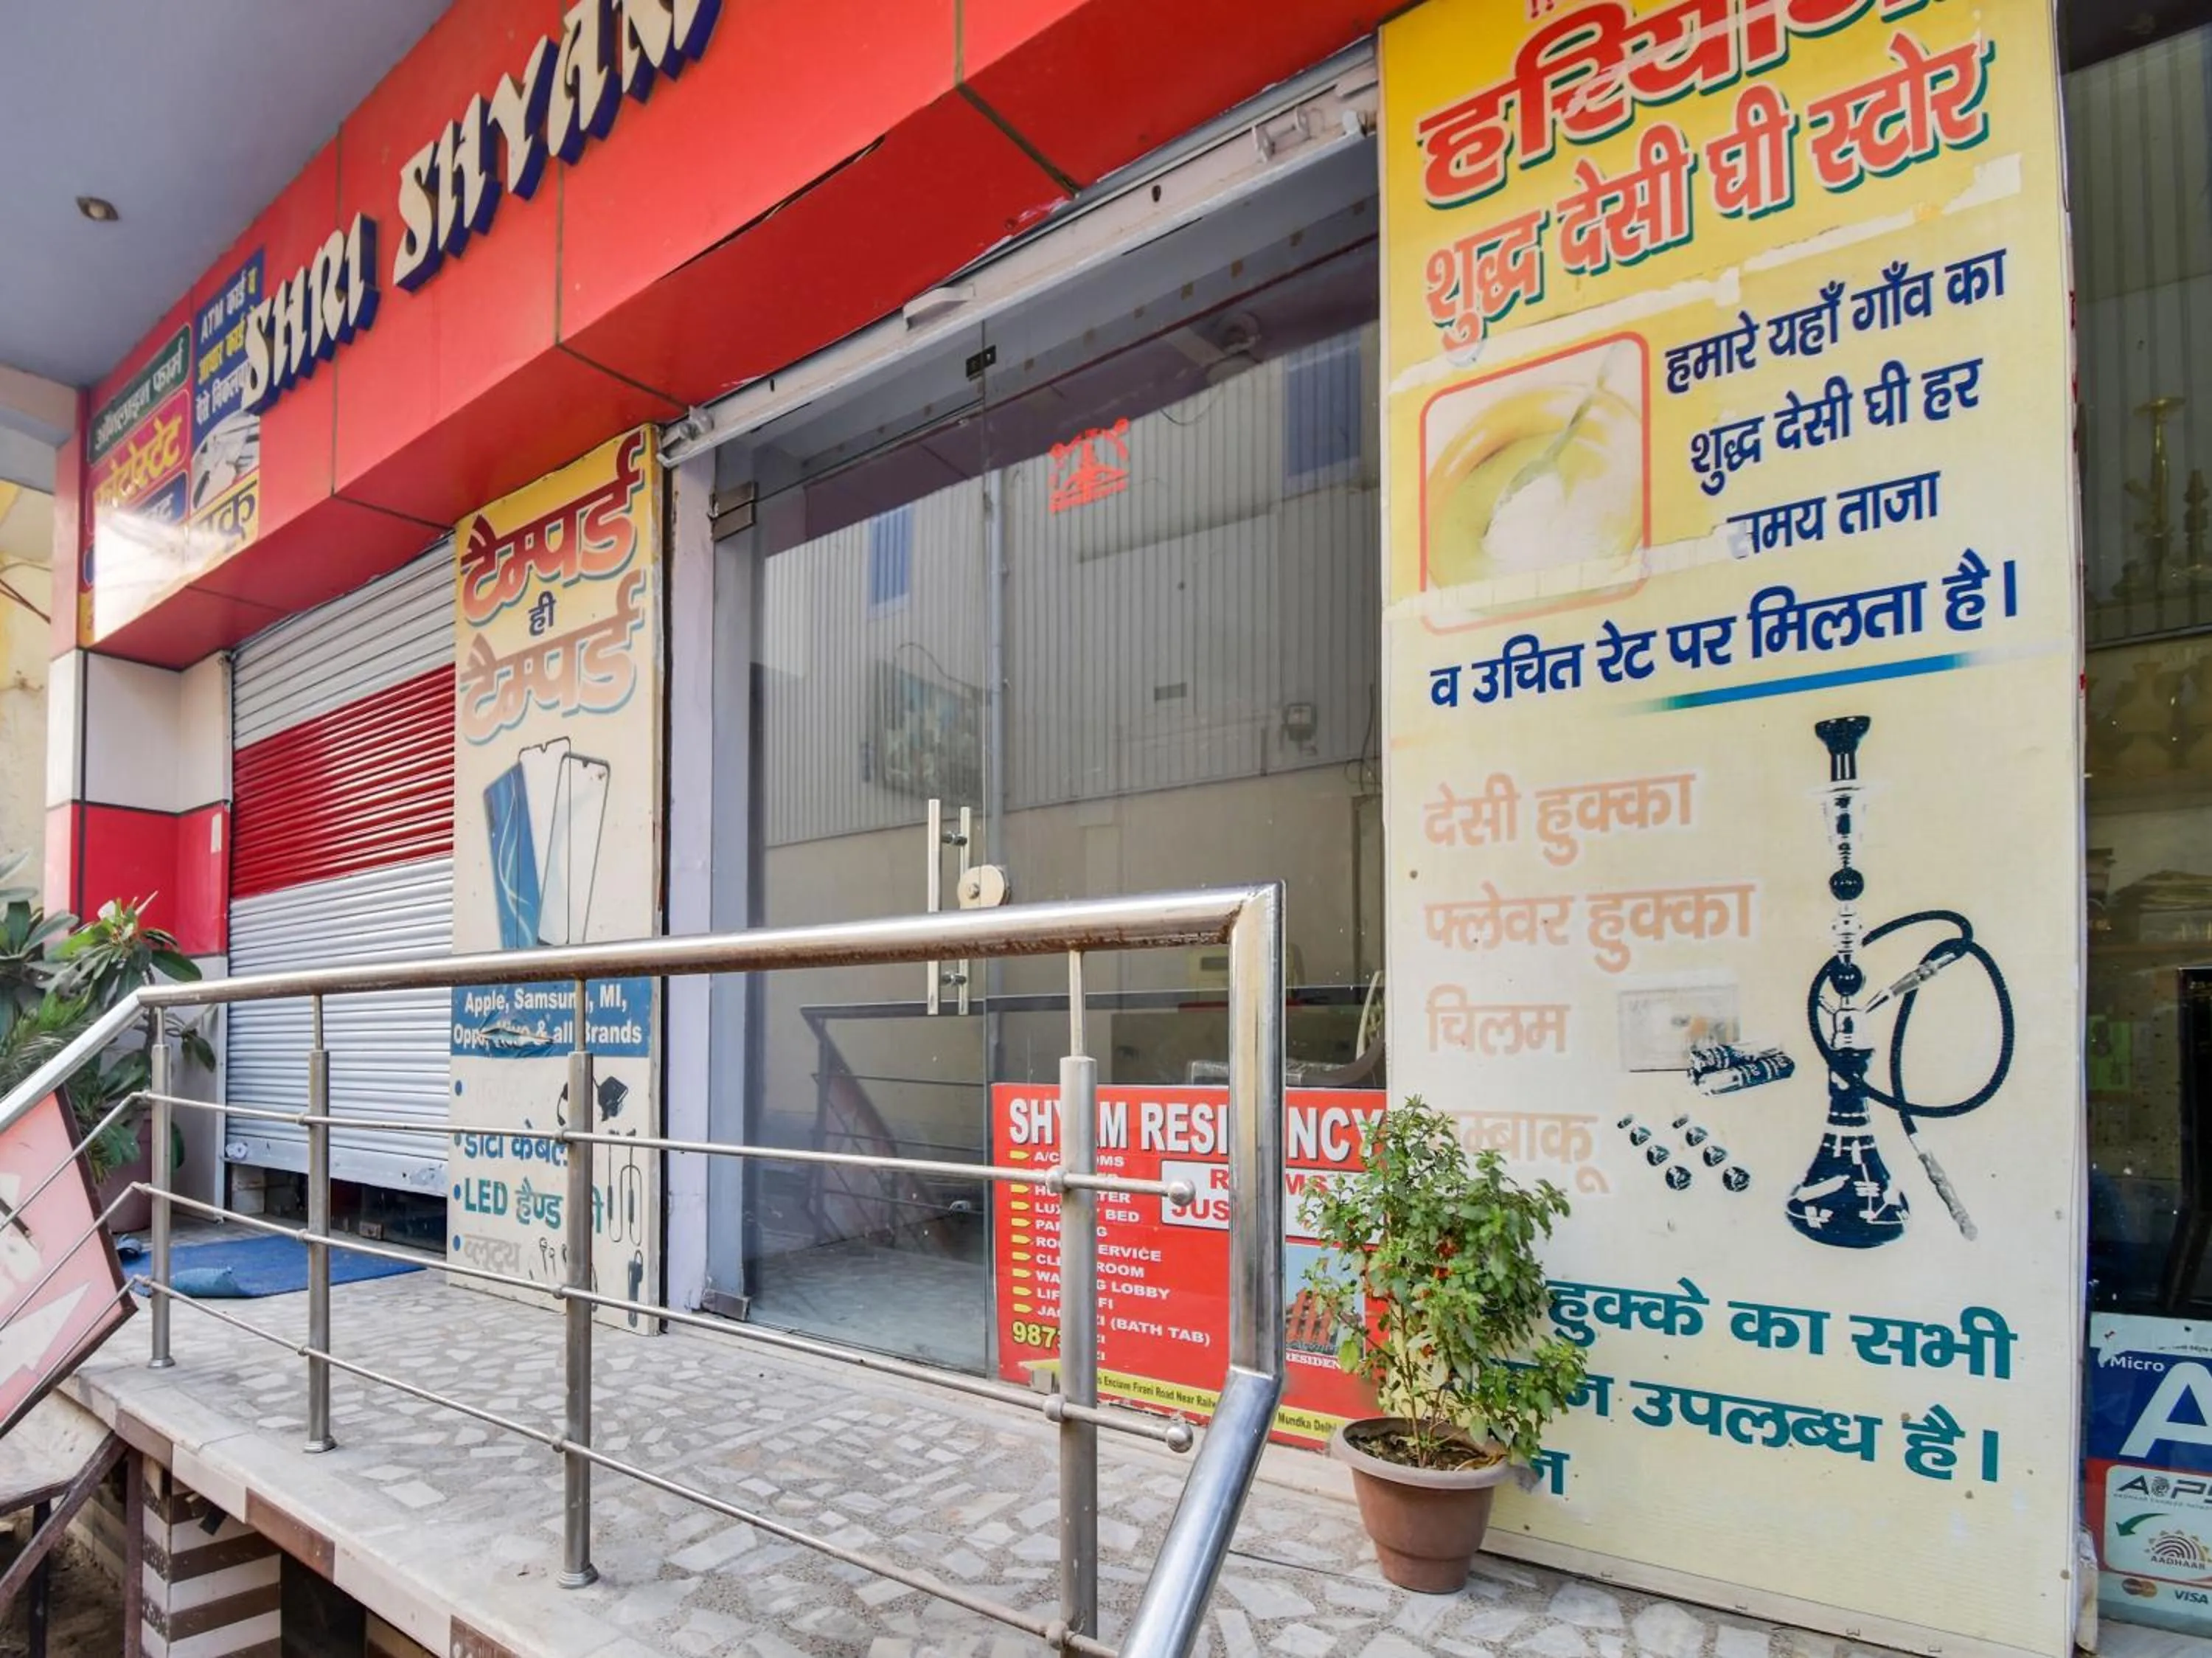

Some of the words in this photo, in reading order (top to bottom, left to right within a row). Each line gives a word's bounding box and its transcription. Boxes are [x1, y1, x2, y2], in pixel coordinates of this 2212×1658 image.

[1417, 0, 1941, 208] हरिया
[1425, 210, 1548, 366] शुद्ध
[1556, 124, 1697, 274] देसी
[1707, 86, 1797, 219] घी
[1808, 33, 1996, 193] स्टोर
[201, 298, 223, 343] ATM
[242, 212, 381, 417] SHRI
[1665, 311, 1759, 395] हमारे
[1767, 280, 1844, 357] यहाँ
[1852, 260, 1934, 333] गाँव
[1944, 248, 2006, 305] का
[1691, 416, 1763, 494] शुद्ध
[1775, 378, 1854, 452] देसी
[1864, 360, 1910, 429] घी
[1923, 357, 1983, 420] हर
[1837, 471, 1940, 534] ताजा
[529, 591, 556, 637] ही
[1430, 665, 1459, 708] व
[1472, 634, 1585, 704] उचित
[1596, 620, 1655, 682] रेट
[1668, 613, 1736, 670] पर
[1748, 578, 1926, 659] मिलता
[1423, 772, 1521, 848] देसी
[1535, 772, 1697, 867] हुक्का
[1423, 881, 1573, 951] फ्लेवर
[1586, 884, 1756, 974] हुक्का
[465, 991, 509, 1017] Apple,
[515, 988, 594, 1013] Samsun,
[599, 984, 627, 1012] MI,
[554, 1021, 573, 1044] all
[1426, 984, 1571, 1055] चिलम
[1009, 1097, 1128, 1148] SHM
[1141, 1102, 1384, 1162] RESINCY
[1449, 1109, 1610, 1195] म्बाकू
[464, 1178, 508, 1215] LED
[1105, 1209, 1139, 1222] BED
[1172, 1199, 1229, 1220] JUS
[1098, 1244, 1162, 1262] ERVICE
[1111, 1282, 1170, 1300] LOBBY
[1111, 1317, 1163, 1336] (BATH
[1168, 1328, 1210, 1347] TAB)
[1546, 1277, 1708, 1348] हुक्के
[1728, 1300, 1831, 1356] का
[1851, 1306, 2018, 1380] सभी
[2110, 1356, 2165, 1372] Micro
[1630, 1380, 1882, 1462] उपलब्ध
[2174, 1590, 2208, 1604] VISA
